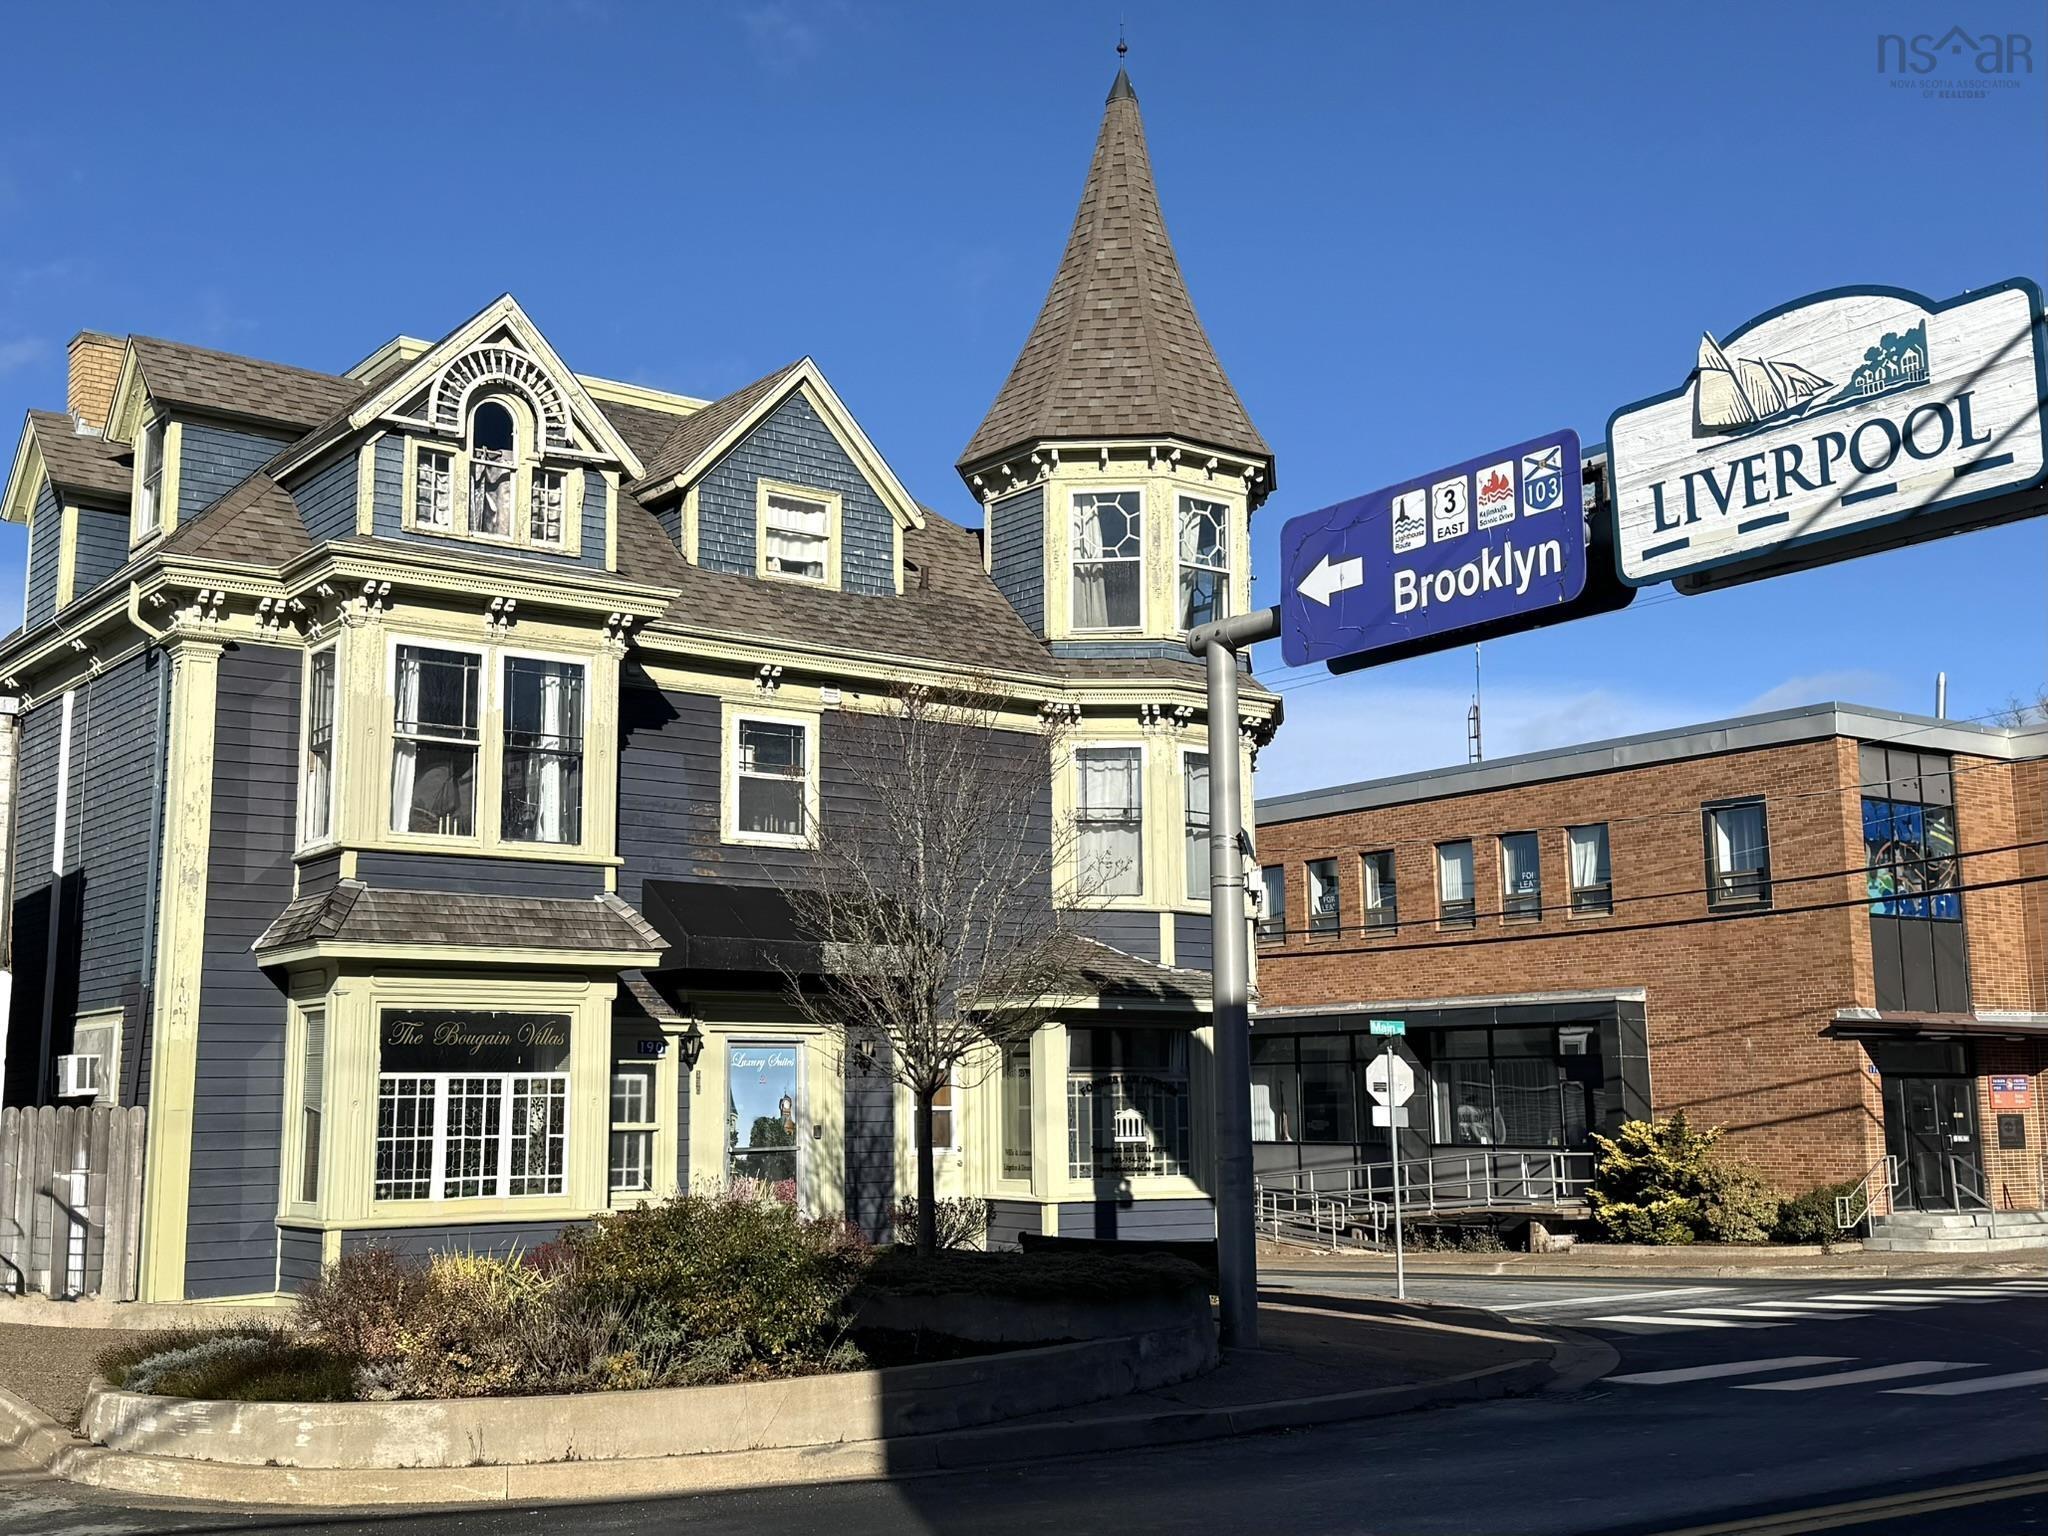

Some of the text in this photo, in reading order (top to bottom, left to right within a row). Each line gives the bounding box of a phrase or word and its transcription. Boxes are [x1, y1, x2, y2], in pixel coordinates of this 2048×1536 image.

[1649, 390, 1992, 534] LIVERPOOL
[1444, 489, 1456, 514] 3
[1528, 477, 1558, 505] 103
[1437, 521, 1465, 539] EAST
[1394, 539, 1563, 615] Brooklyn
[388, 1020, 565, 1056] The Bougain Villas
[641, 1041, 664, 1054] 190
[731, 1051, 795, 1072] Luxury Suites
